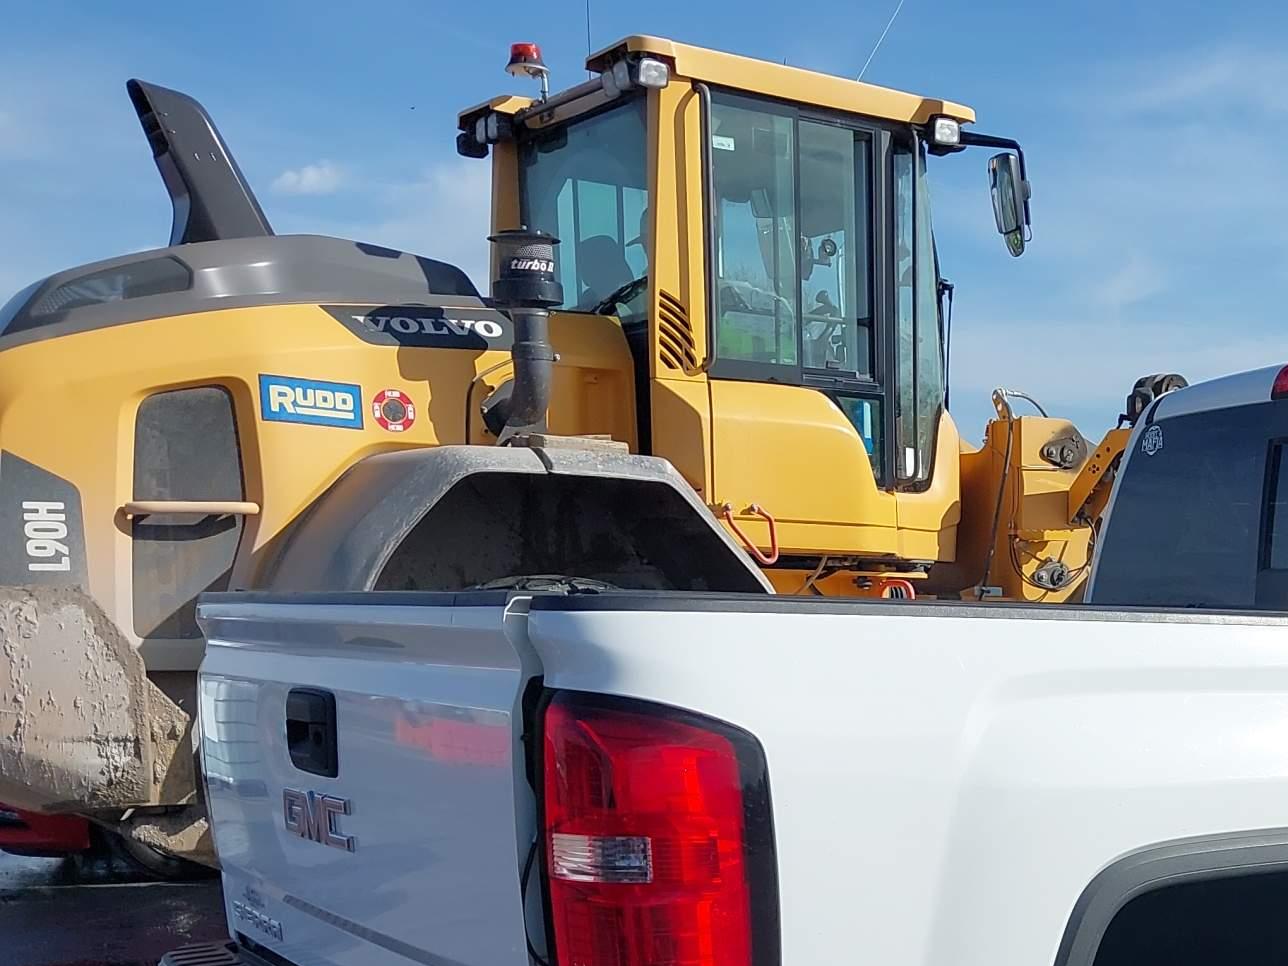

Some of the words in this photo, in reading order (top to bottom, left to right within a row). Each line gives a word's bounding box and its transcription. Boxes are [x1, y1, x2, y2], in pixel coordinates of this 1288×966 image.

[352, 315, 503, 338] VOLVO
[268, 384, 355, 414] RUDD
[22, 501, 71, 571] L90H
[283, 786, 355, 854] GMC
